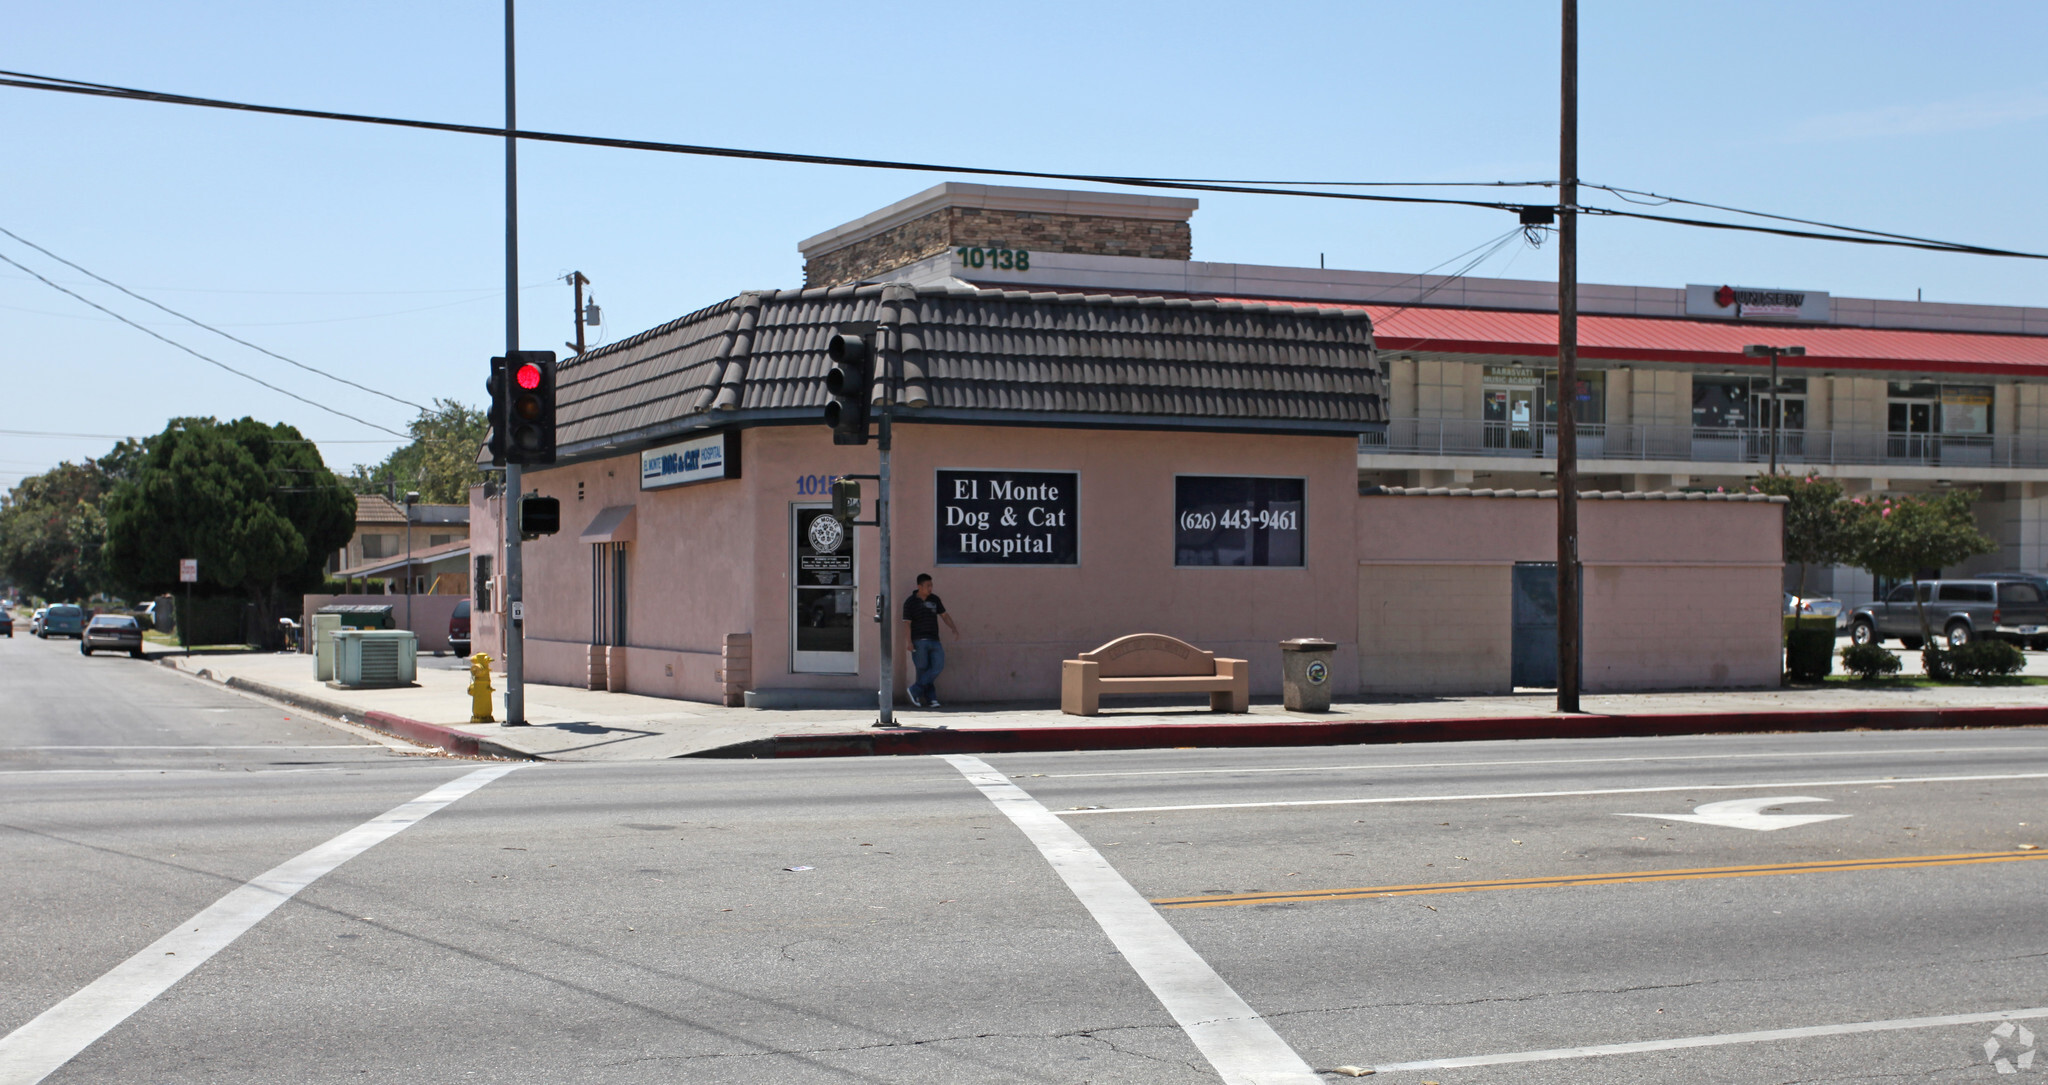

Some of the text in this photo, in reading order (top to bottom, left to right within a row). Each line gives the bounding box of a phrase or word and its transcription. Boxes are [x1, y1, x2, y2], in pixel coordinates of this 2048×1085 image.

[957, 247, 1029, 271] 10138
[1483, 376, 1542, 385] MUSIC ACADEMY
[649, 457, 661, 470] MONTE
[661, 453, 677, 475] DOG
[678, 456, 684, 472] &
[684, 449, 700, 471] CAT
[701, 446, 721, 461] HOSPITAL
[954, 479, 1059, 501] El Monte
[821, 517, 838, 528] MONTE
[945, 506, 1066, 530] Dog & Cat
[1180, 509, 1297, 531] (626) 443-9461
[960, 533, 1052, 557] Hospital
